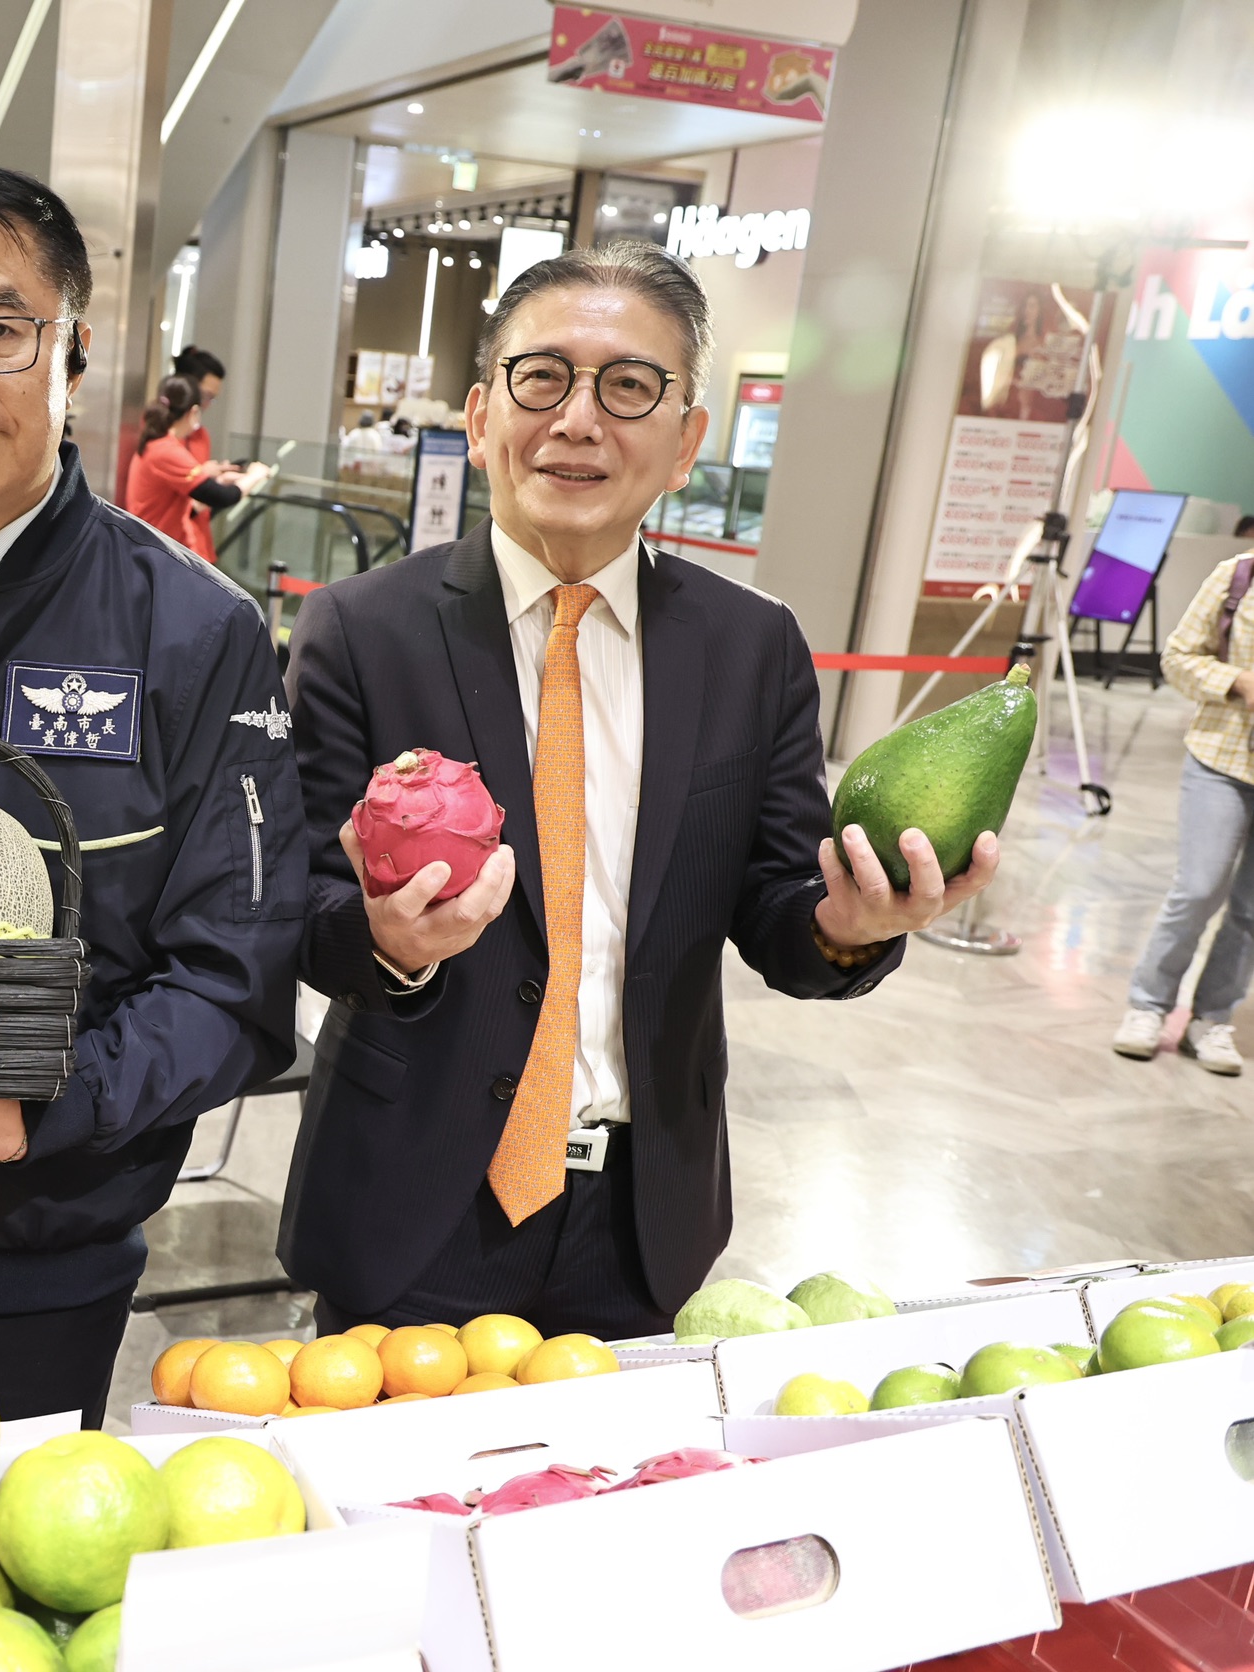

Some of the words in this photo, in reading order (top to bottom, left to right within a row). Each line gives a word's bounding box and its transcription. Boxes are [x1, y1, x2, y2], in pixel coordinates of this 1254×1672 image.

[666, 204, 810, 269] Häagen
[29, 713, 116, 735] 臺南市長
